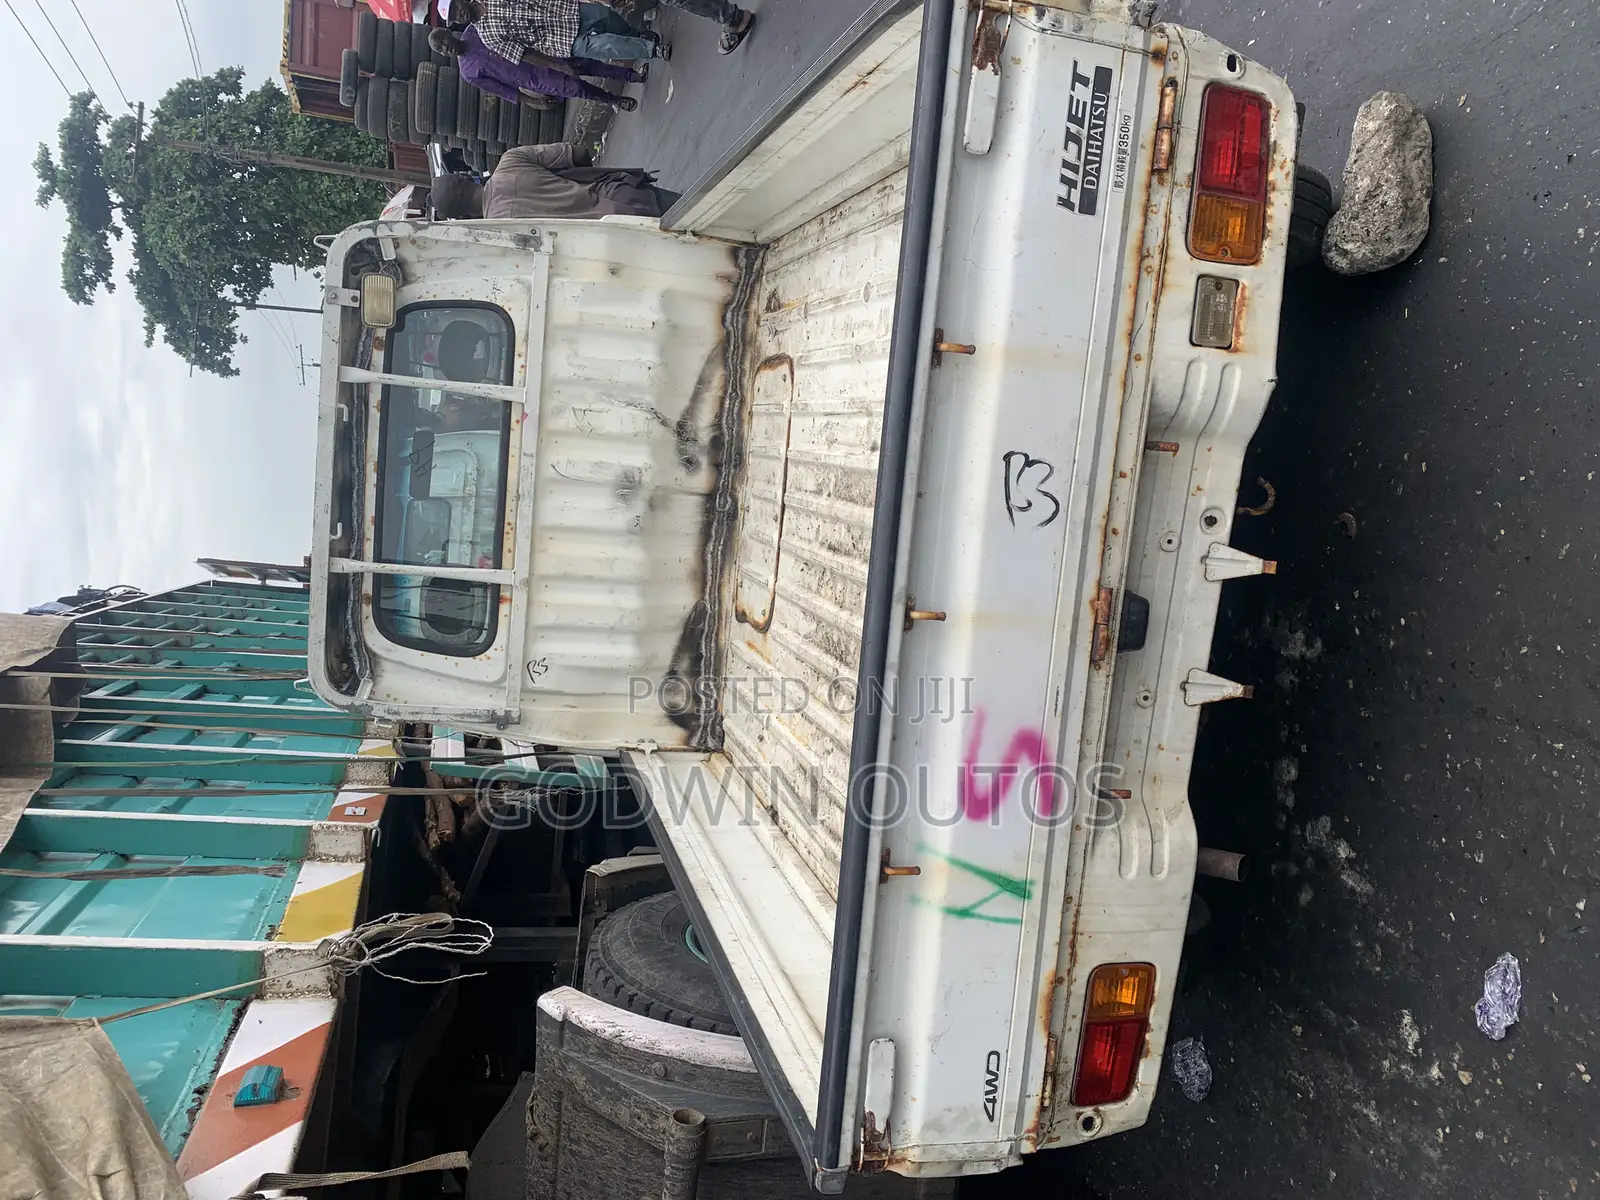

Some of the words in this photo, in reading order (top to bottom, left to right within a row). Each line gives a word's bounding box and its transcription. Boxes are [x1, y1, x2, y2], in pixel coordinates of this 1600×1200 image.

[1057, 59, 1090, 212] HIJET
[1083, 91, 1109, 190] DAIHATSU
[983, 1050, 1001, 1123] 4WD
